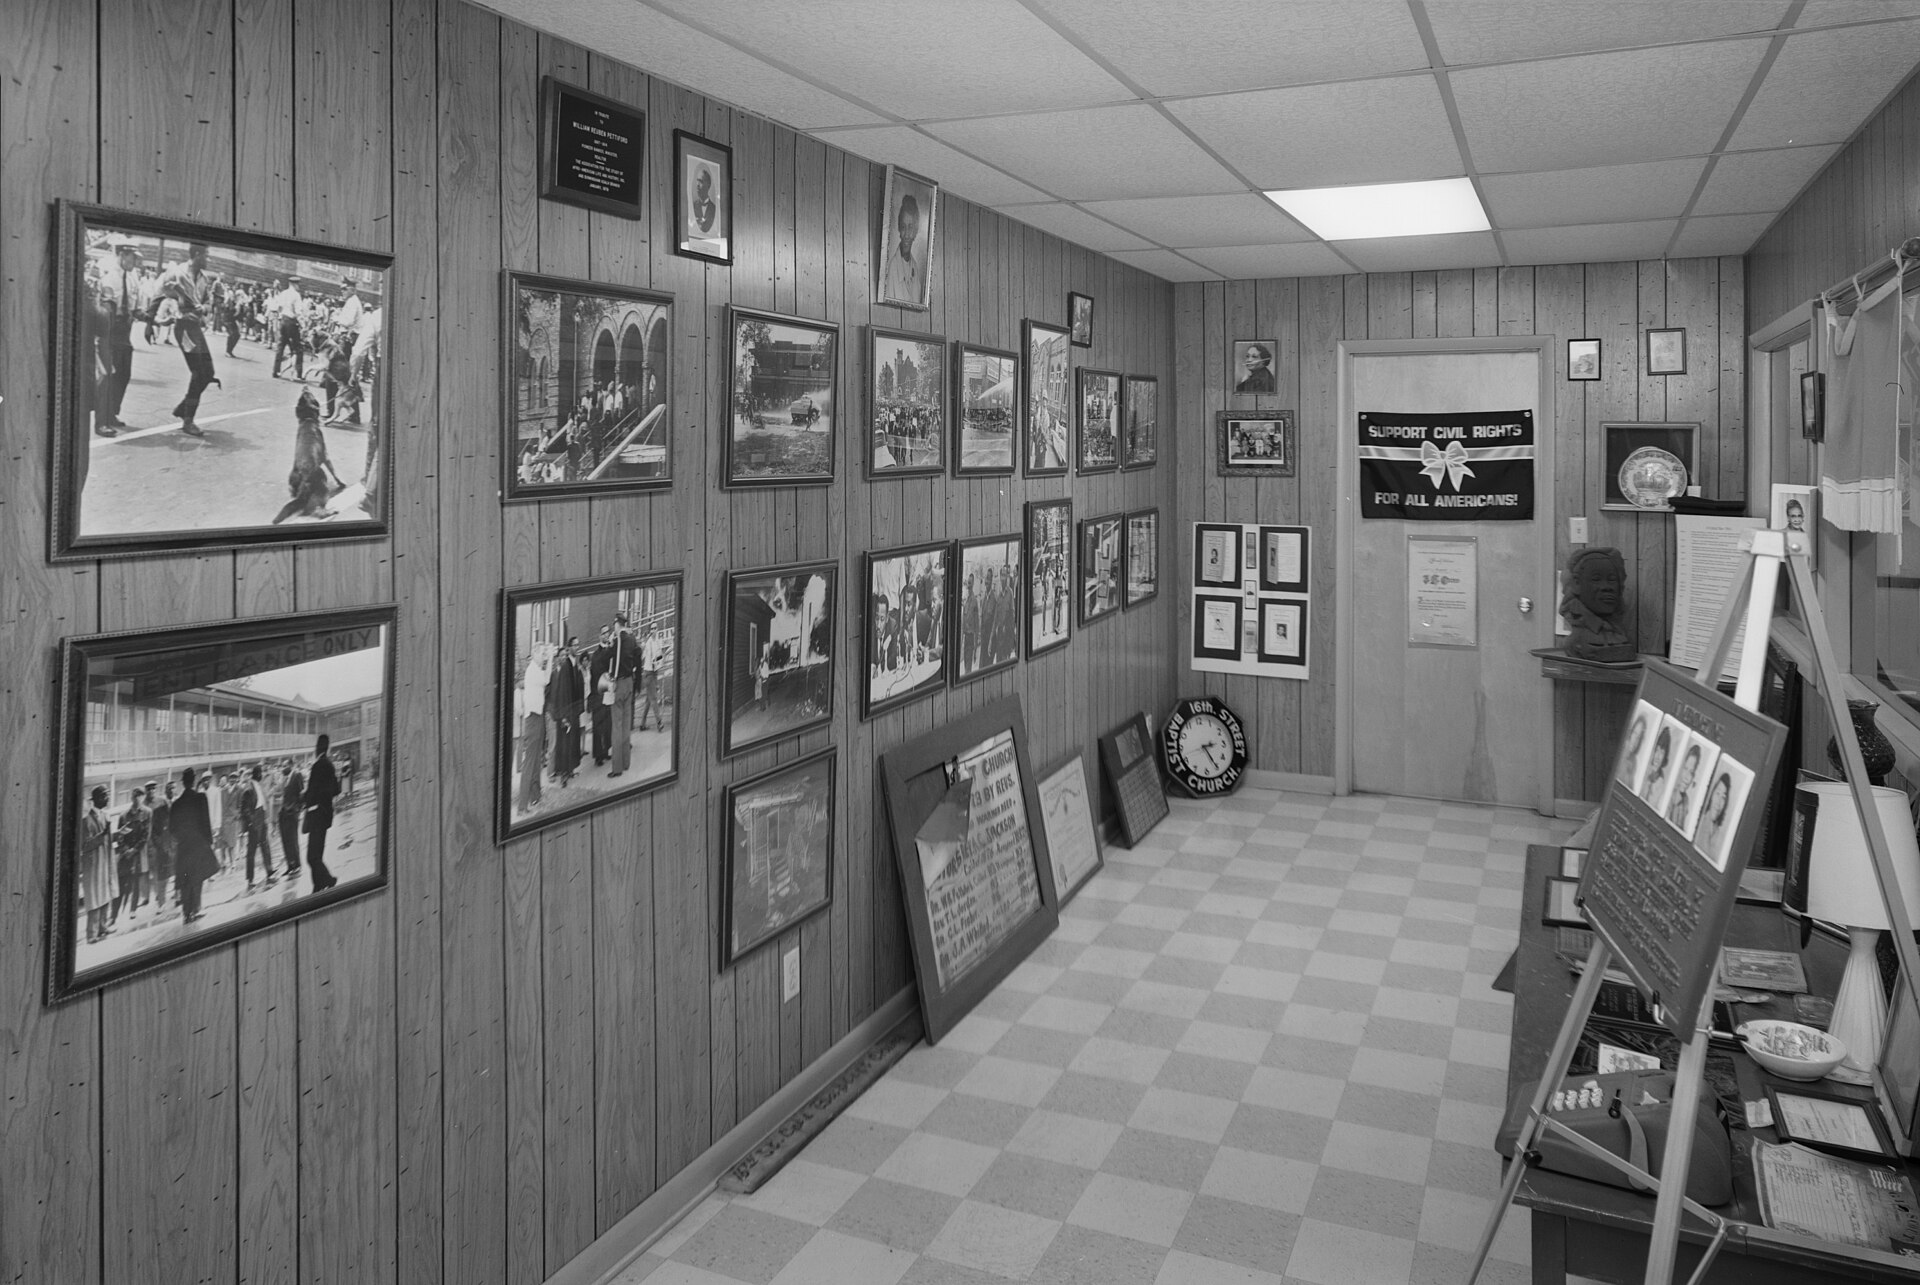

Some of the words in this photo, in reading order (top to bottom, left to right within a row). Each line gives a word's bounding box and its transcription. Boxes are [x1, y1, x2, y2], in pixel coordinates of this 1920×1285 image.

[573, 121, 590, 132] WILLIAM
[591, 126, 607, 137] REUBEN
[607, 131, 628, 144] PETTIFORD
[1368, 425, 1428, 438] SUPPORT
[1434, 426, 1467, 439] CIVIL
[1473, 424, 1523, 438] RIGHTS
[1375, 492, 1399, 505] FOR
[1405, 494, 1430, 507] ALL
[1435, 493, 1519, 507] AMERICANS!
[322, 628, 372, 654] ONLY
[1166, 712, 1187, 773] BAPTIST
[1218, 708, 1246, 758] STREET
[982, 745, 1013, 775] CHURCH
[983, 783, 995, 802] BY
